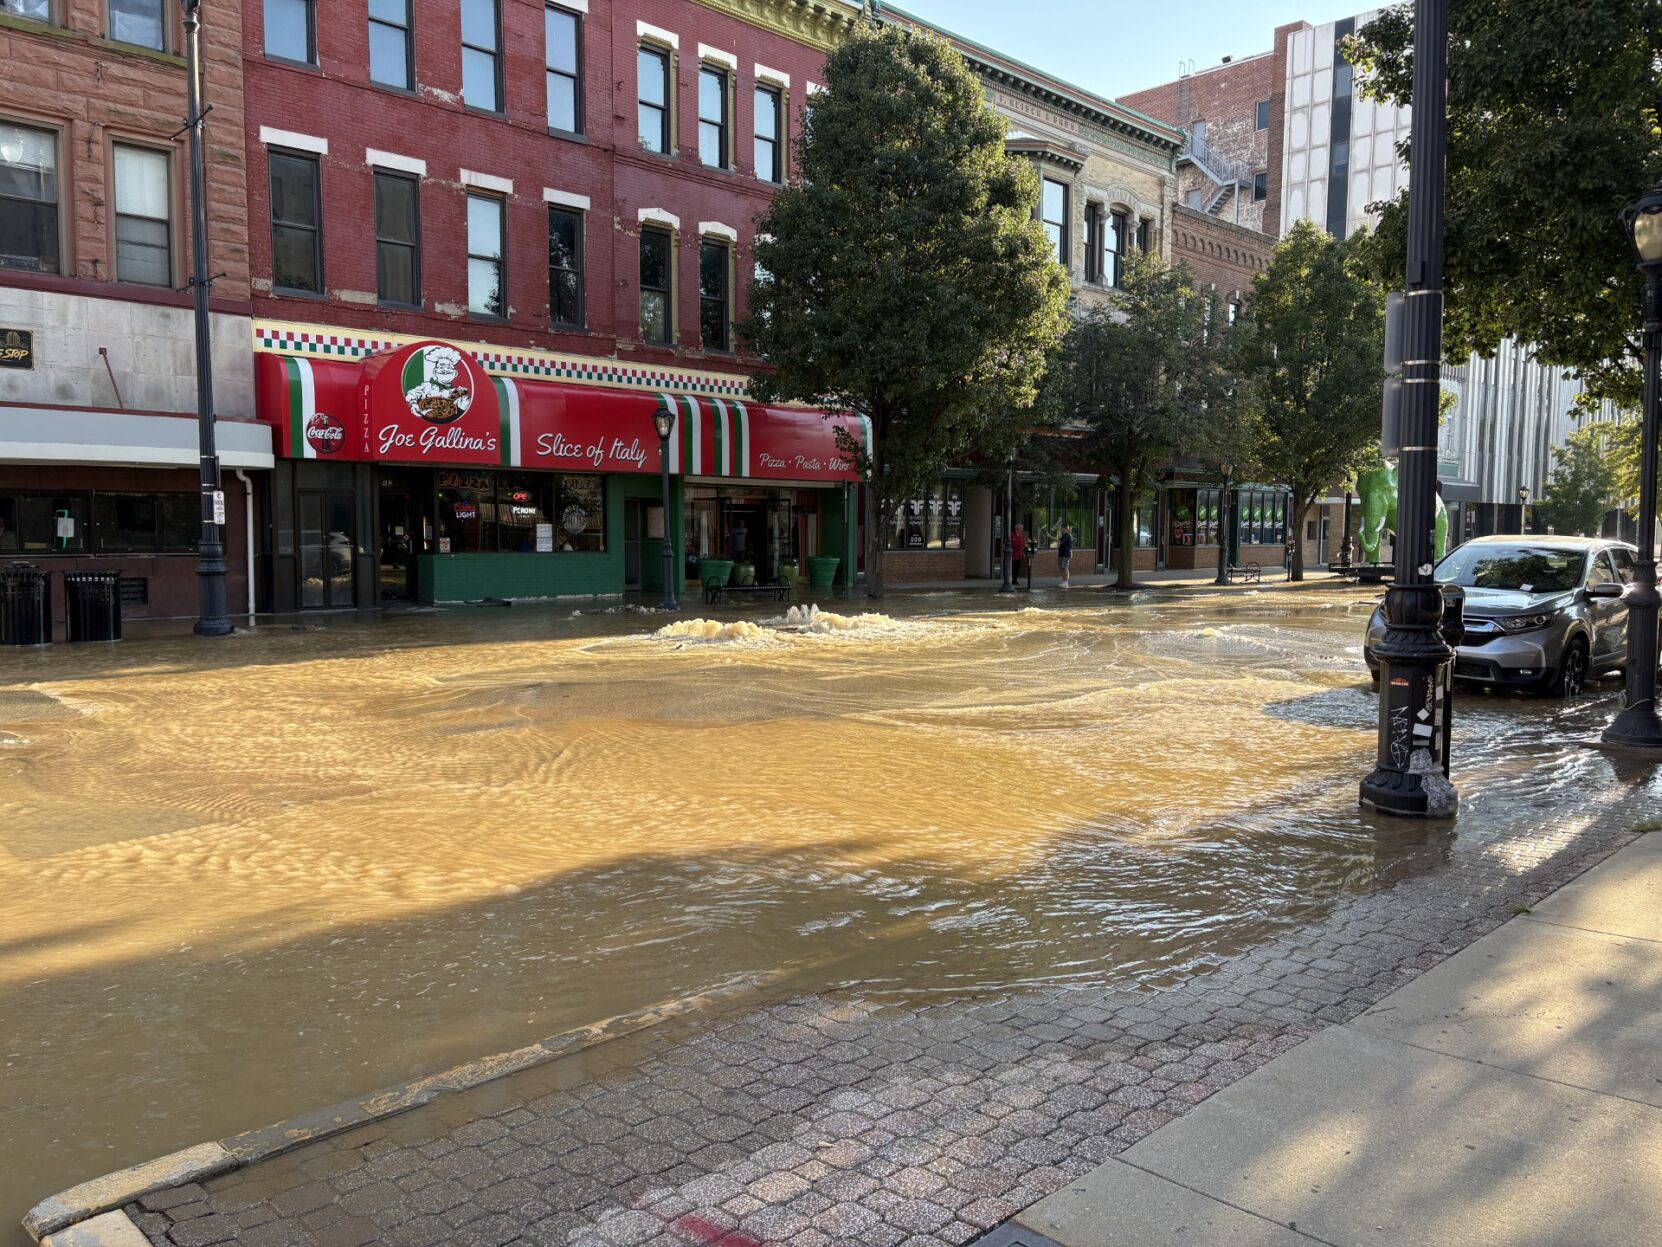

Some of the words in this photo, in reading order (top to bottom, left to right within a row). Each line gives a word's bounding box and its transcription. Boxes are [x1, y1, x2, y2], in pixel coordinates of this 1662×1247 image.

[3, 348, 29, 360] STOP
[307, 425, 344, 440] Coca-Cola
[379, 424, 416, 454] Joe
[420, 426, 497, 455] Gallina's
[536, 433, 583, 458] Slice
[586, 436, 605, 467] of
[609, 438, 648, 469] Italy
[760, 453, 786, 468] Pizza
[795, 455, 821, 470] Pasta
[440, 474, 489, 489] PIZZA
[513, 492, 531, 500] OPE
[456, 511, 476, 519] LIGHT
[512, 506, 536, 515] PERONI
